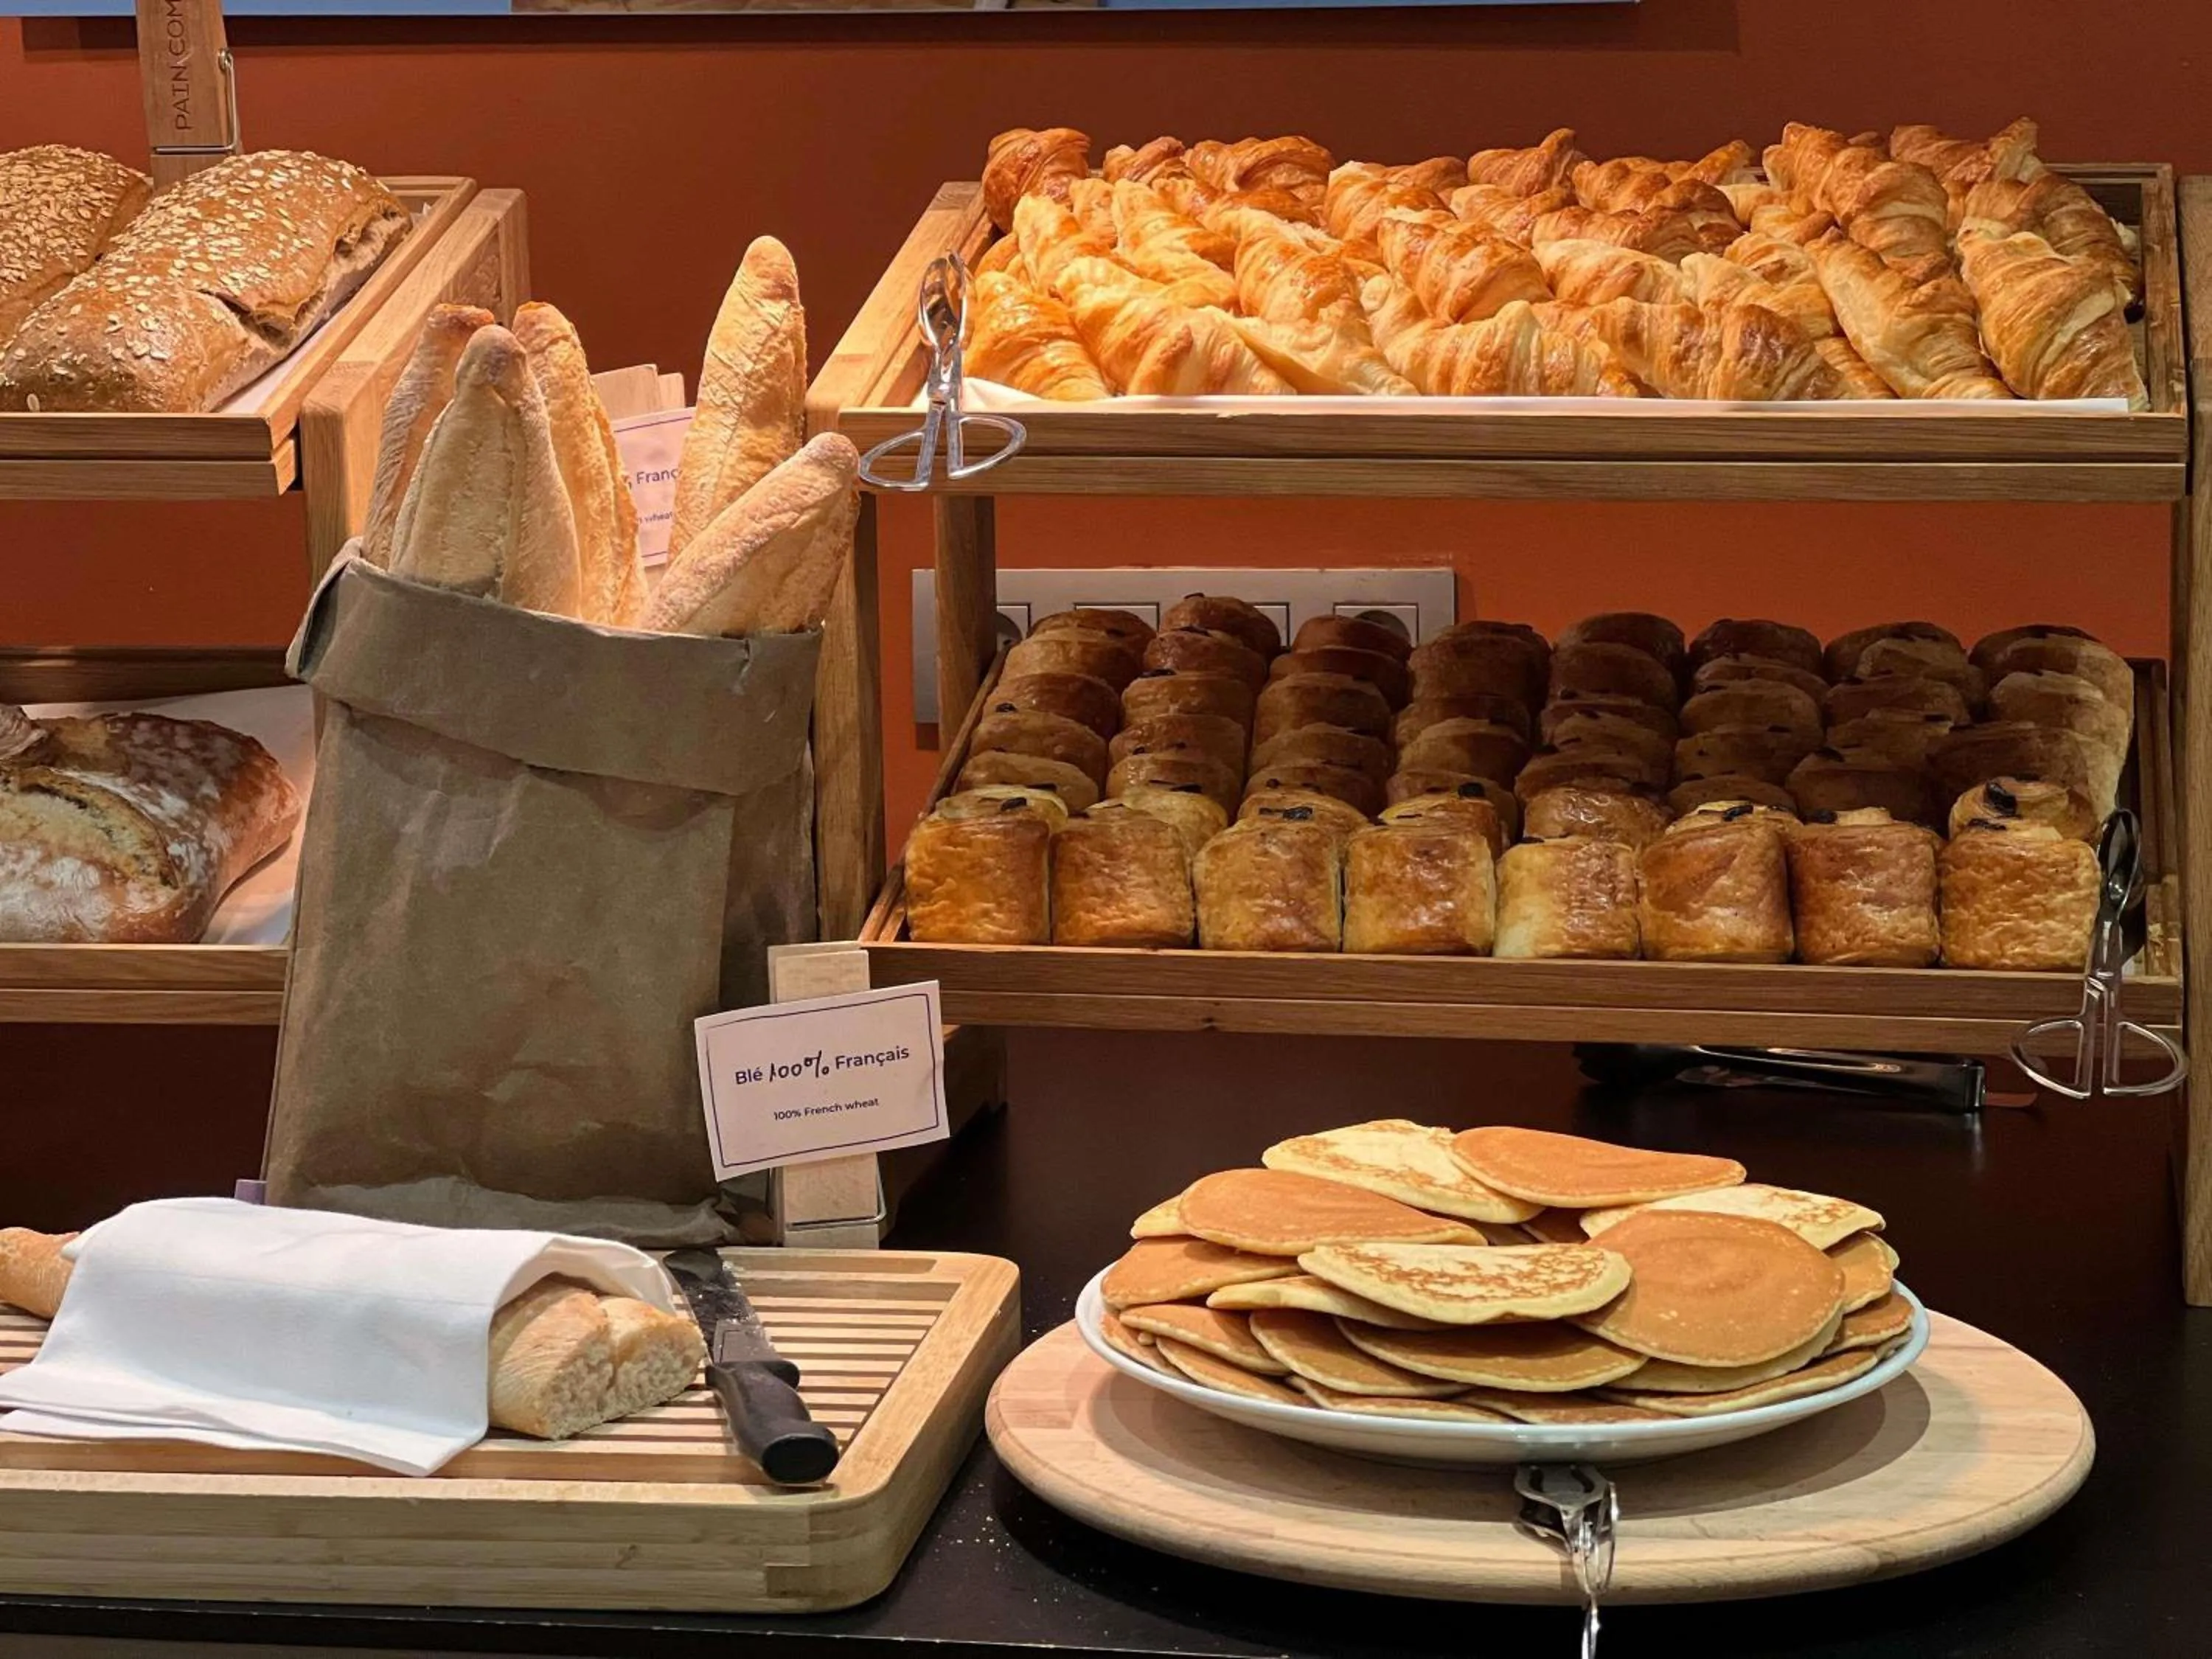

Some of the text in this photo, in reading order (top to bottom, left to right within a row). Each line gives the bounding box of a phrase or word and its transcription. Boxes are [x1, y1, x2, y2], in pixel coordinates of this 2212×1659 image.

[170, 66, 192, 130] PAIN
[735, 1067, 762, 1085] Blé
[835, 1046, 910, 1069] Français
[774, 1098, 879, 1121] 100% French wheat
